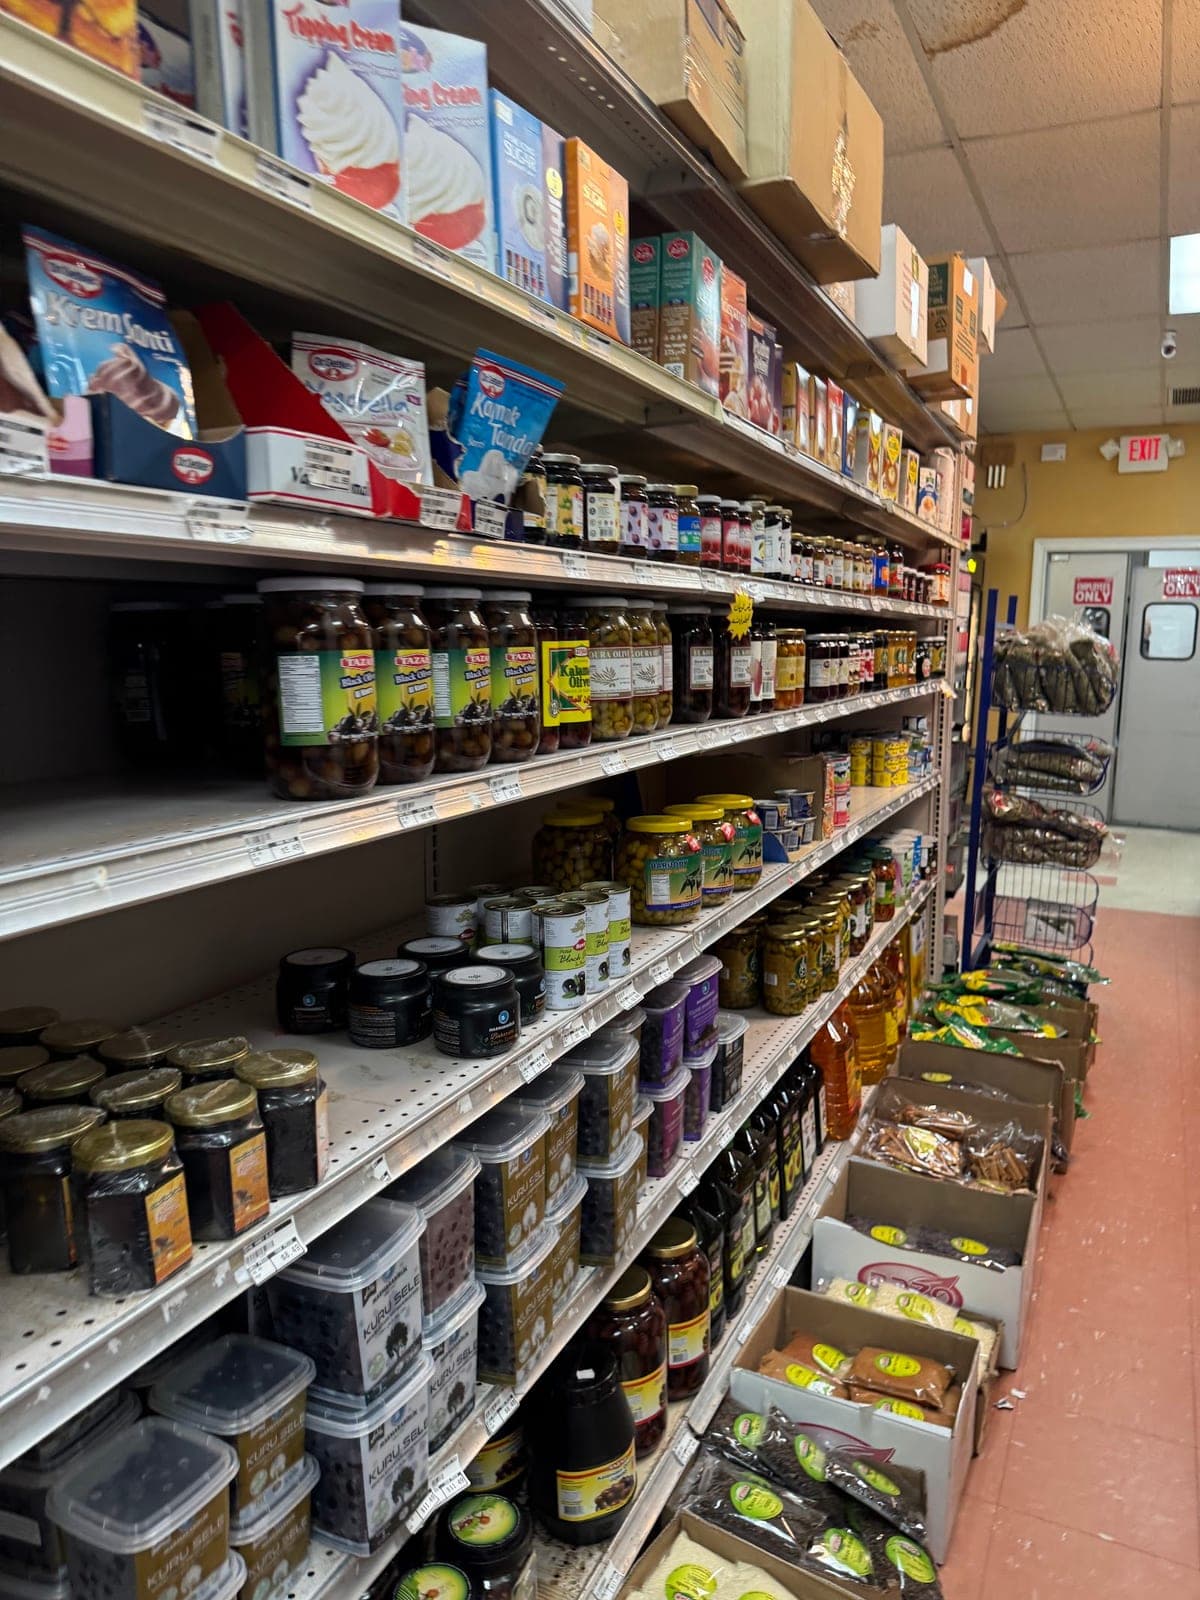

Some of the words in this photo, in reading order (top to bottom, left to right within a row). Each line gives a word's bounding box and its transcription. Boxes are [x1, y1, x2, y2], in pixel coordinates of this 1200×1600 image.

[350, 19, 397, 53] Cream
[1129, 437, 1162, 462] EXIT
[1075, 591, 1111, 603] ONLY
[363, 1299, 392, 1340] KURU
[393, 1273, 421, 1307] SELE
[430, 1361, 456, 1394] KURU
[246, 1434, 279, 1470] KURU
[369, 1444, 401, 1485] KURU
[147, 1546, 190, 1590] KURU
